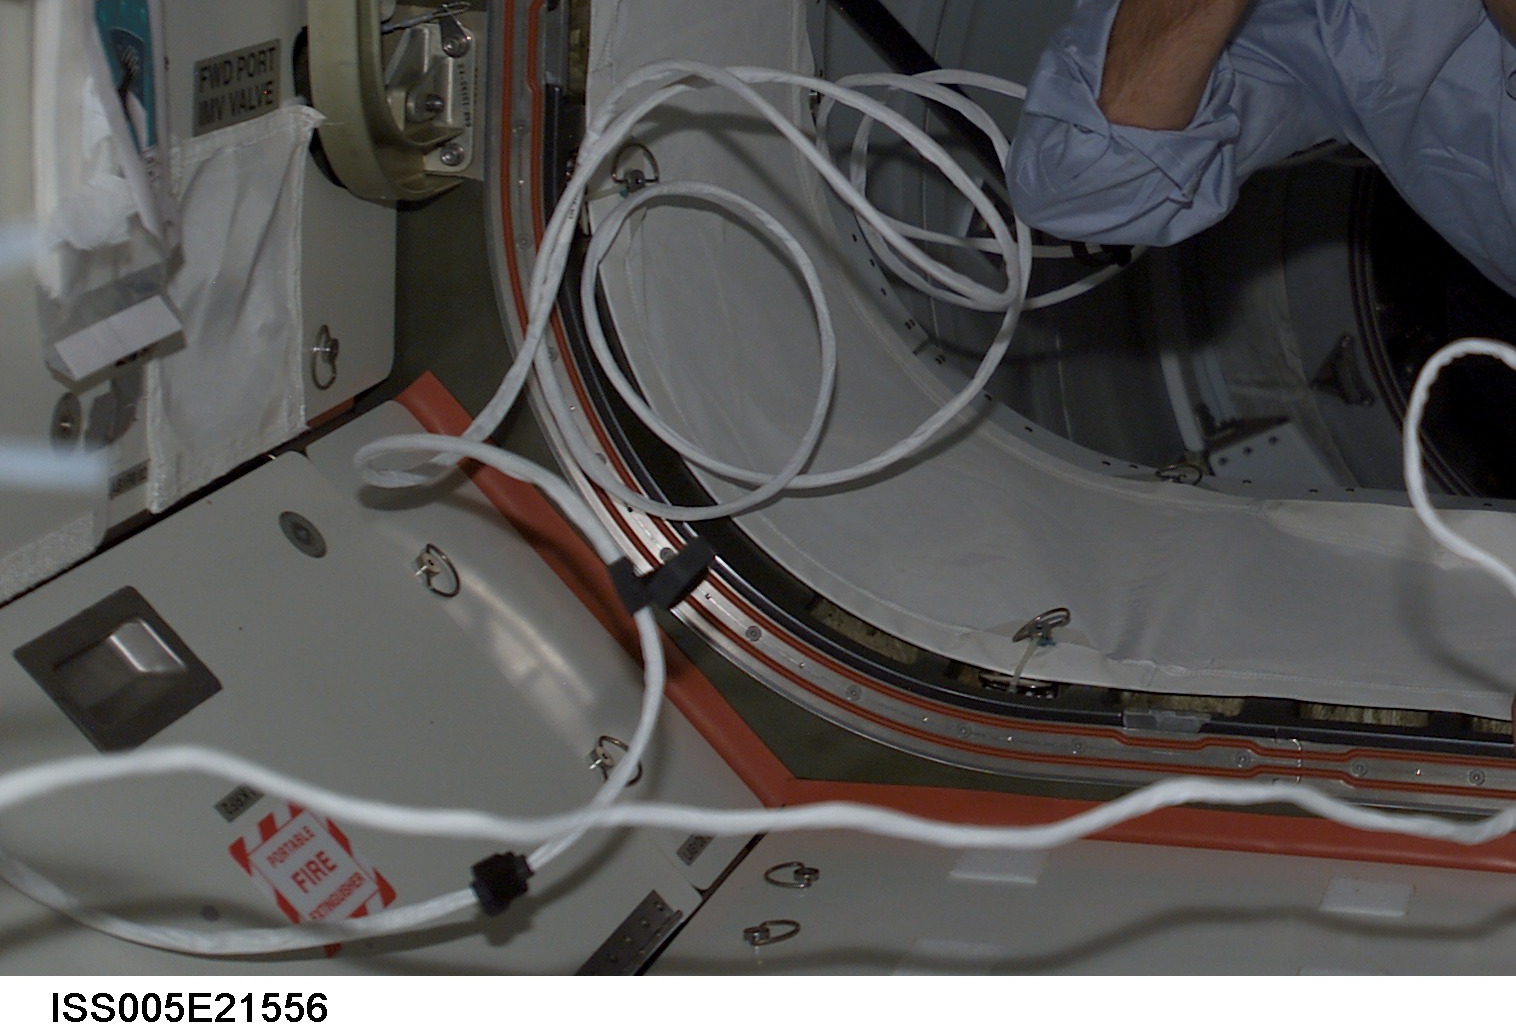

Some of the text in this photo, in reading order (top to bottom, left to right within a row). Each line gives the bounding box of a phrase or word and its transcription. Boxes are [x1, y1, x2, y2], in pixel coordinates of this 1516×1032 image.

[199, 47, 276, 93] FWD PORT
[198, 81, 274, 126] IMV VALVE
[265, 825, 317, 867] PORTABLE
[291, 850, 338, 894] FIRE
[309, 871, 366, 921] EXTINGUISHER
